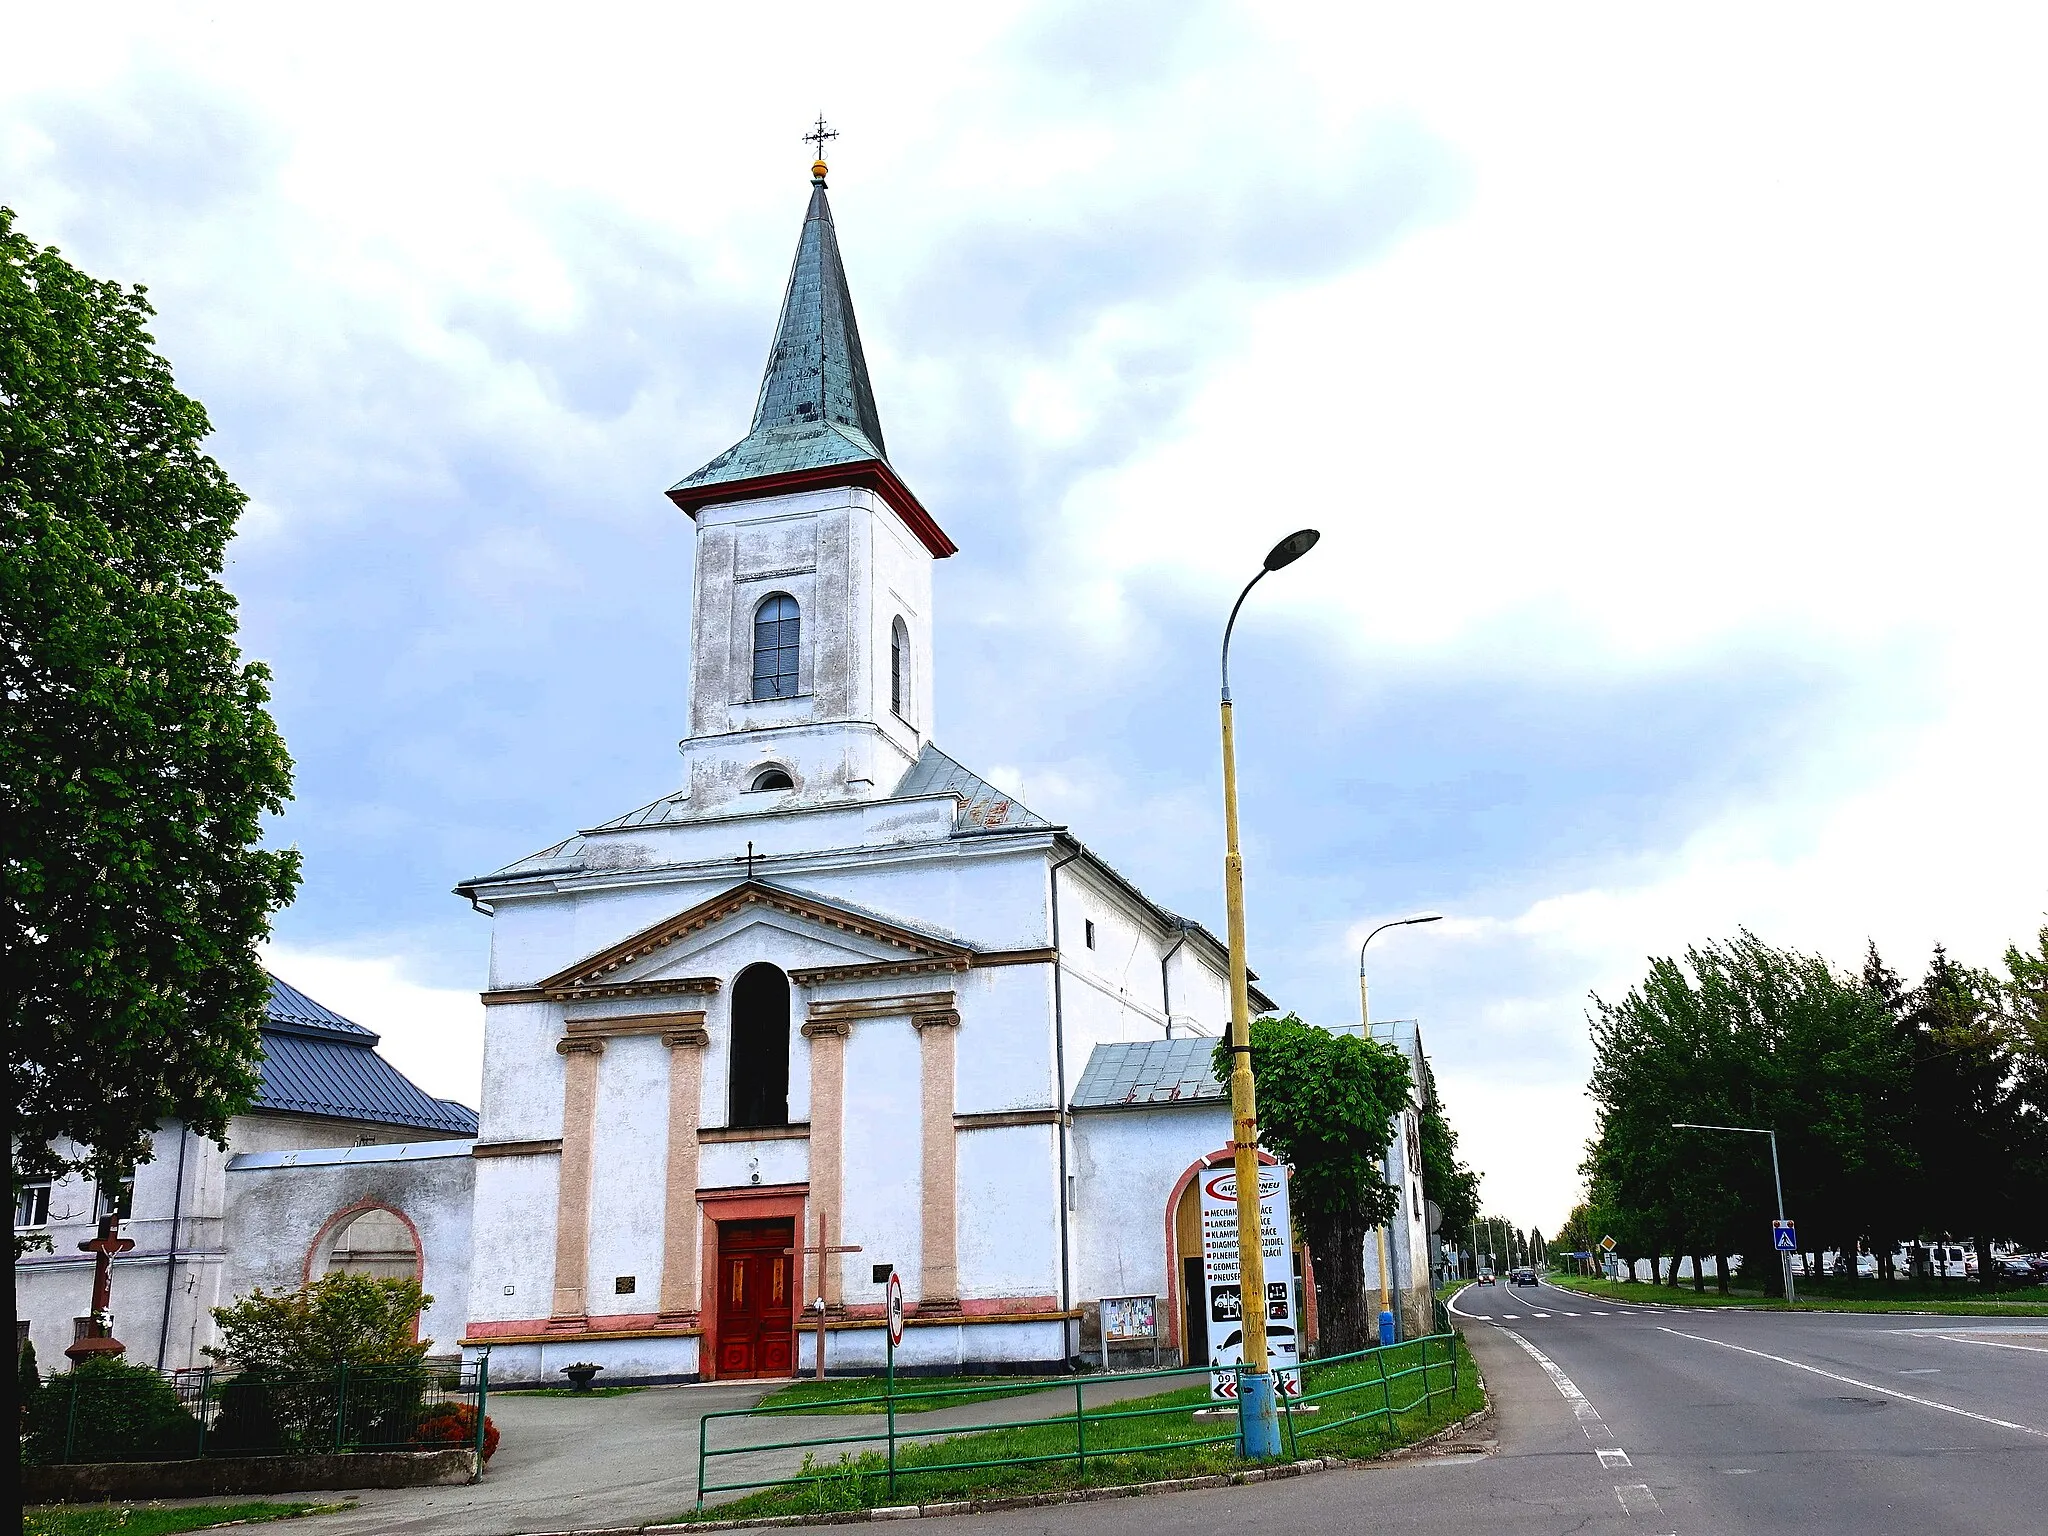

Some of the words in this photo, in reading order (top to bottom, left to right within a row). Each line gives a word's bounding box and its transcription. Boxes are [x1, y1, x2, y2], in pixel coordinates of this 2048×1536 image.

[1210, 1208, 1238, 1217] MECHAN
[1210, 1217, 1238, 1228] LAKERNÍ
[1260, 1226, 1277, 1236] RÁCE
[1211, 1240, 1240, 1249] DIAGNOS
[1261, 1237, 1284, 1246] OZIDIEL
